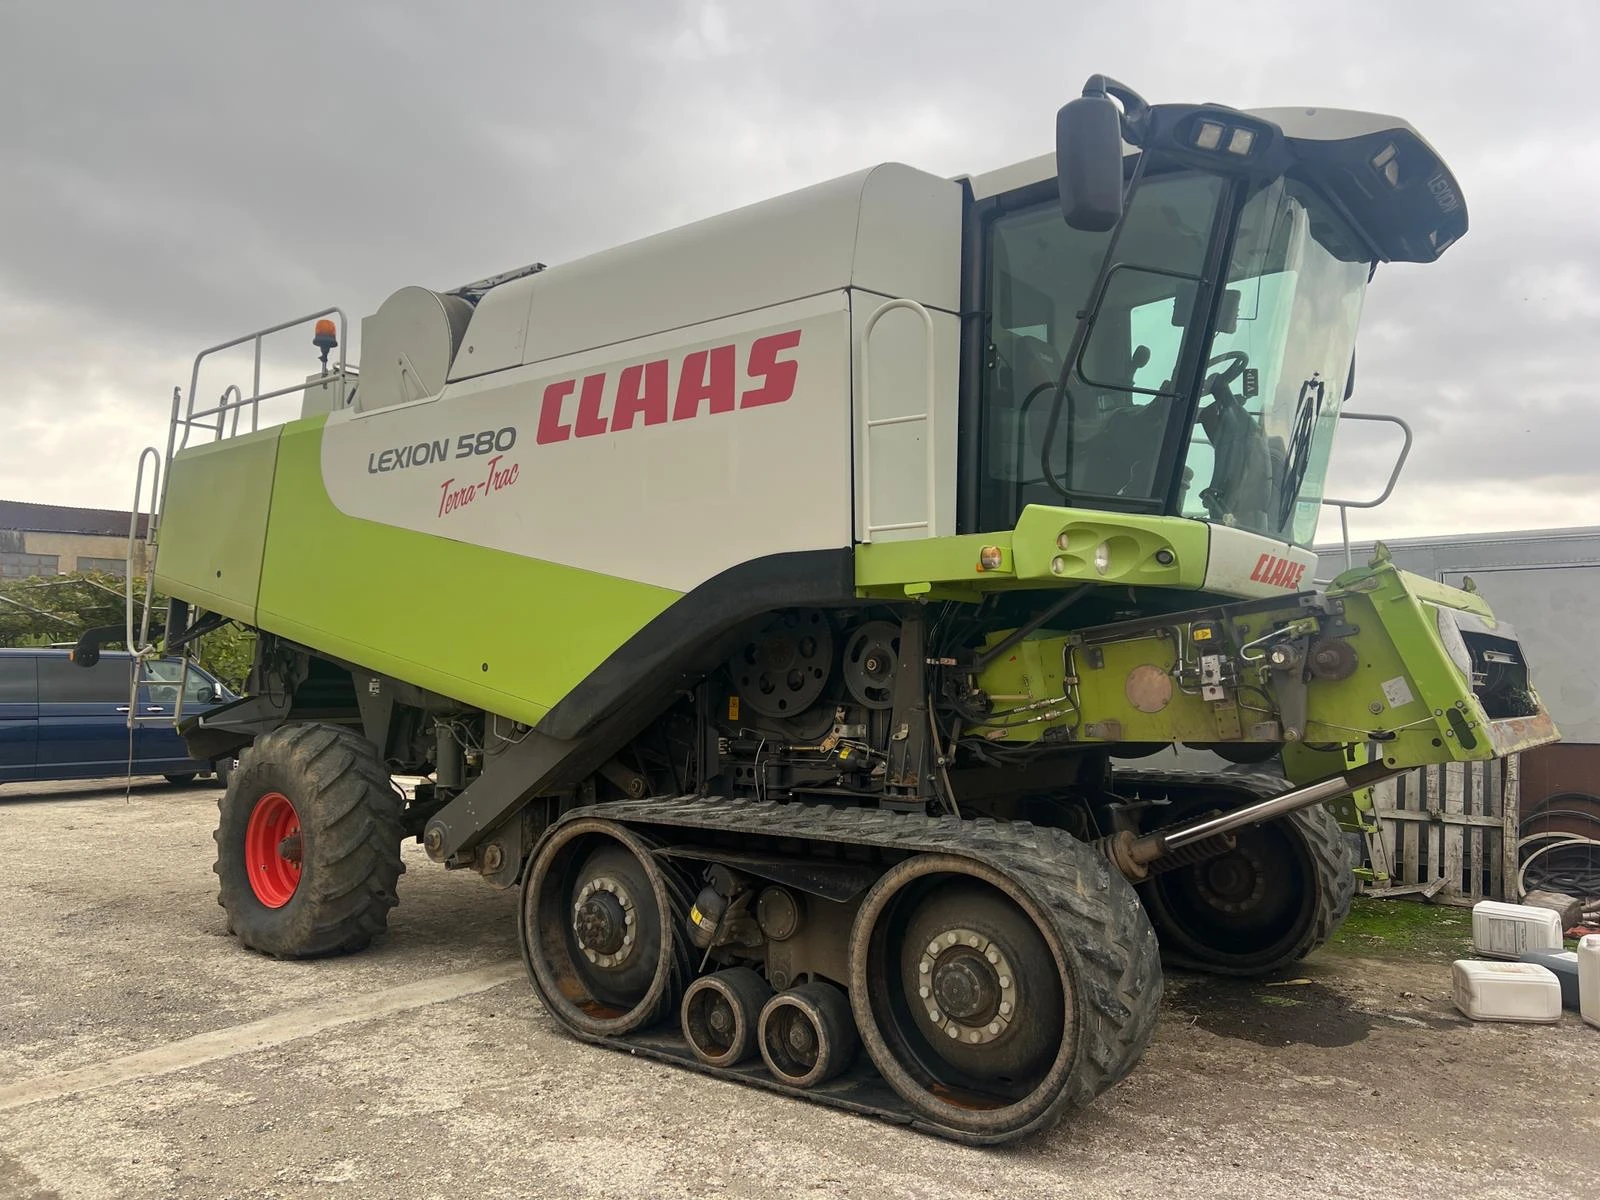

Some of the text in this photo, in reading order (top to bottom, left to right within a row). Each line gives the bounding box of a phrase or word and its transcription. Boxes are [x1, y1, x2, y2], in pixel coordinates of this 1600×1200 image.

[536, 329, 802, 445] CLAAS
[368, 426, 517, 474] LEXION 580
[437, 455, 519, 518] Terra-Trac
[1250, 553, 1305, 590] CLAAS
